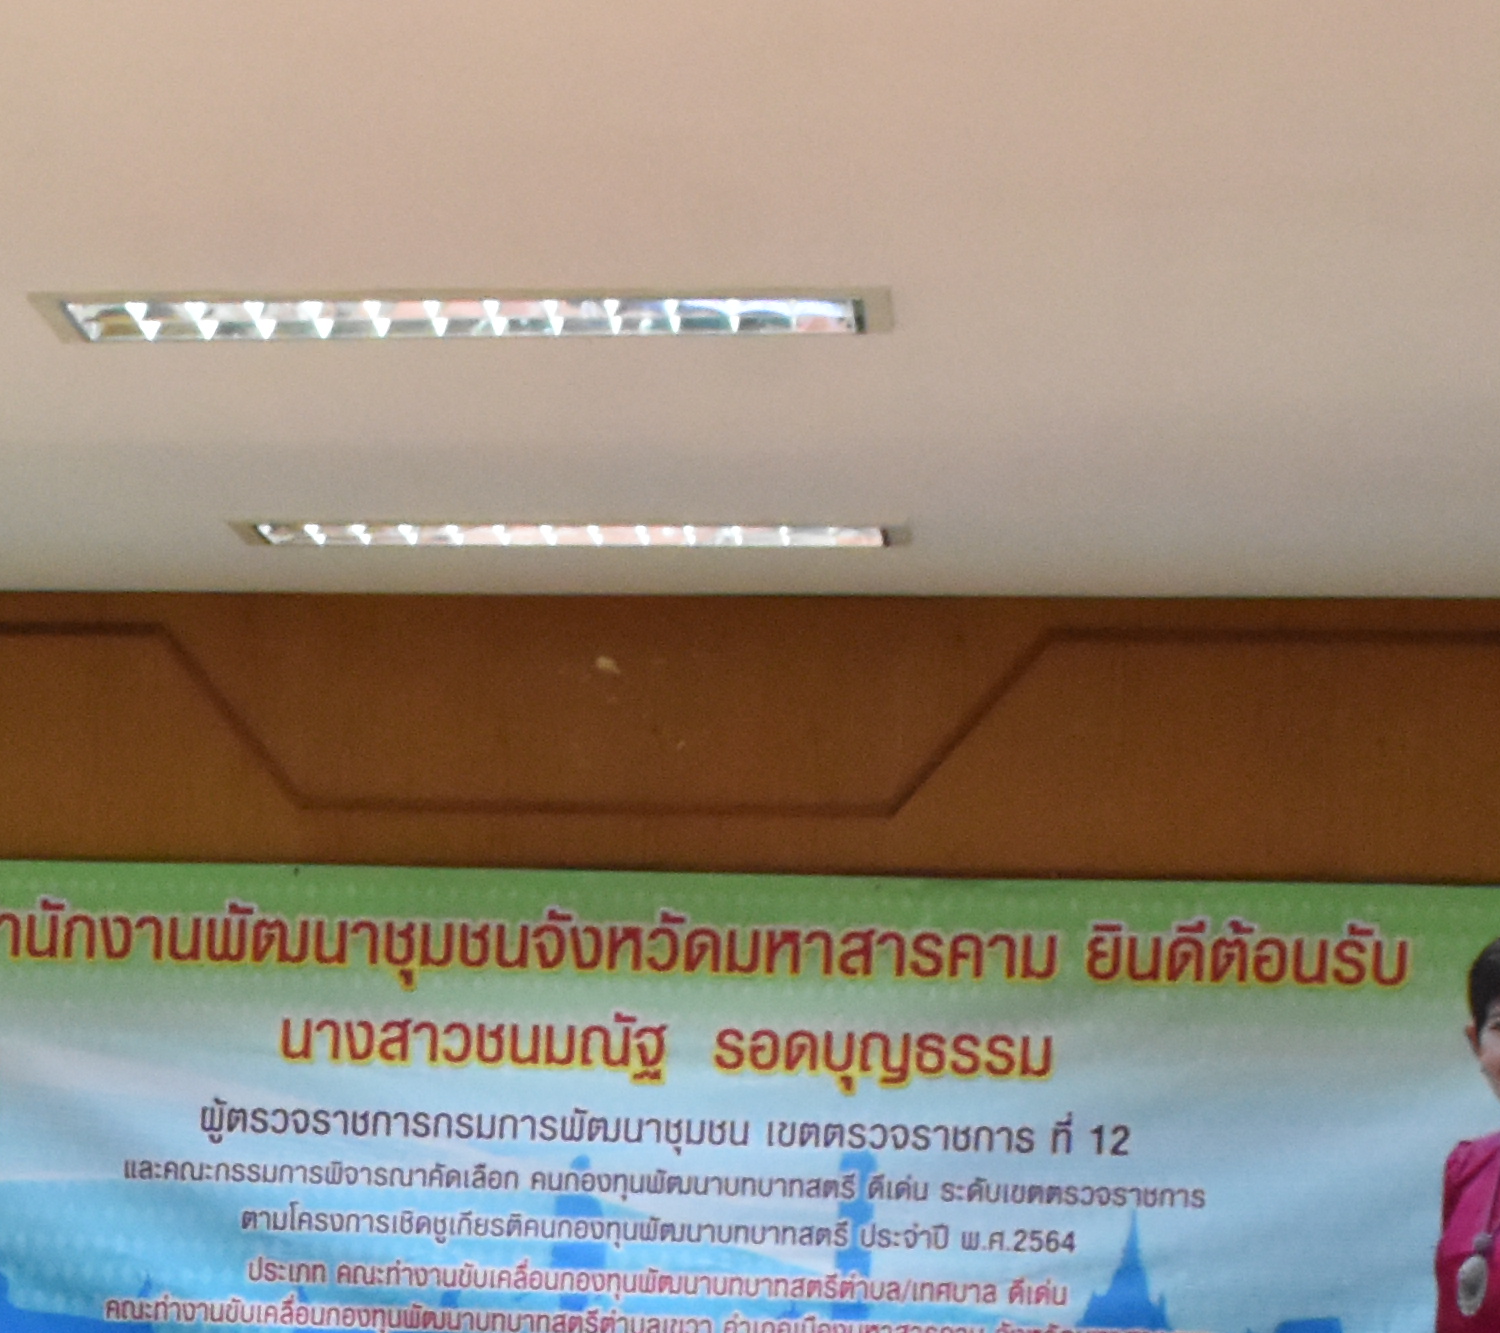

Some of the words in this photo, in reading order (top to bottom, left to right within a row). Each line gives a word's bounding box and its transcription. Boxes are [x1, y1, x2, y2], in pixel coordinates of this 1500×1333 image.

[1085, 917, 1411, 988] ยินดีต้อนรับ
[279, 1011, 666, 1081] นางสาวชนมณัฐ
[714, 1027, 1054, 1092] รอดบุญธรรม
[200, 1097, 750, 1155] ผู้ตรวจราชการกรมการพัฒนาชุมชน
[766, 1119, 1035, 1154] เขตตรวจราชการ
[1050, 1111, 1074, 1155] ที่
[1090, 1124, 1132, 1157] 12
[123, 1157, 519, 1191] และคณะกรรมการพิจารณาคัดเลือก
[530, 1167, 856, 1203] คนกองทุนพัฒนาบทบาทสตรี
[868, 1174, 930, 1202] ดีเด่น
[940, 1176, 1207, 1209] ระดับเขตตรวจราชการ
[859, 1221, 950, 1251] ประจำปี
[960, 1227, 1077, 1253] พ.ศ.2564
[248, 1256, 327, 1285] ประเภท
[1008, 1281, 1068, 1307] ดีเด่น
